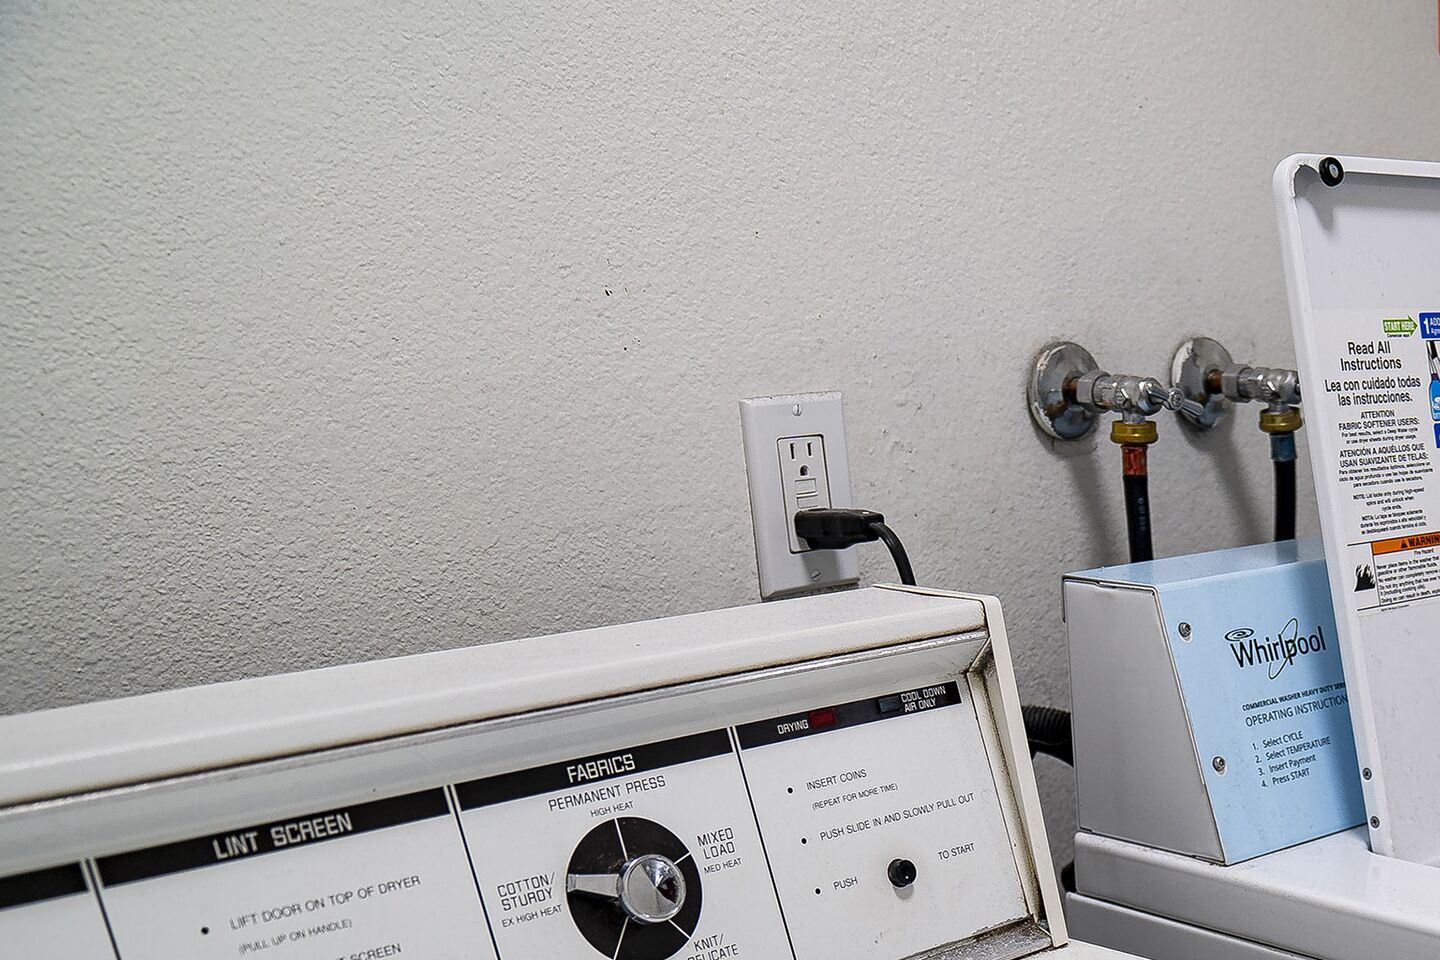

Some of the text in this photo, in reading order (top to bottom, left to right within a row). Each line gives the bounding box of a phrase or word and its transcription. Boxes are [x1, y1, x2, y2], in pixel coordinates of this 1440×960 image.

[1384, 320, 1414, 331] START HERE
[1423, 318, 1430, 334] 1
[1348, 341, 1391, 355] Read All
[1340, 357, 1402, 372] Instructions
[1325, 375, 1421, 392] Lea con cuidado todas
[1338, 391, 1413, 406] las instrucciones.
[1338, 417, 1420, 430] FABRIC SOFTENER USERS:
[1360, 410, 1395, 419] ATTENTION
[1340, 447, 1371, 458] ATENCIÓN
[1412, 443, 1424, 451] QUE
[1340, 460, 1358, 468] USAN
[1359, 456, 1397, 466] SUAVIZANTE
[1230, 626, 1327, 668] Whirlpool
[901, 686, 946, 703] COOL DOWN
[1242, 697, 1278, 711] COMMERCIAL
[1279, 692, 1301, 703] WASHER
[1302, 687, 1319, 698] HEAVY
[1320, 684, 1333, 694] DUTY
[904, 699, 937, 713] AIR ONLY
[777, 719, 809, 735] DRYING
[1245, 707, 1293, 727] OPERATING
[1252, 731, 1303, 751] 1. Select CYCLE
[1255, 736, 1330, 764] 2. Select TEMPERATURE
[566, 754, 636, 783] FABRICS
[1258, 754, 1317, 777] 3. Insert Payment
[806, 769, 868, 790] INSERT COINS
[1261, 767, 1310, 788] 4. Press START
[549, 775, 666, 812] PERMANENT PRESS
[812, 782, 898, 811] (REPEAT FOR MORE TIME)
[590, 801, 634, 818] HIGH HEAT
[819, 792, 975, 841] PUSH SLIDE IN AND SLOWLY PULL OUT
[213, 812, 353, 860] LINT SCREEN
[697, 827, 734, 846] MIXED
[703, 842, 735, 860] LOAD
[704, 858, 742, 875] MED HEAT
[833, 842, 976, 891] PUSH TO START
[497, 872, 555, 898] COTTON/
[230, 875, 420, 930] LIFT DOOR ON TOP OF DRYER
[501, 888, 553, 911] STURDY
[501, 905, 563, 928] EX HIGH HEAT
[239, 918, 353, 955] (PULL UP ON HANDLE)
[693, 933, 723, 952] KNIT/
